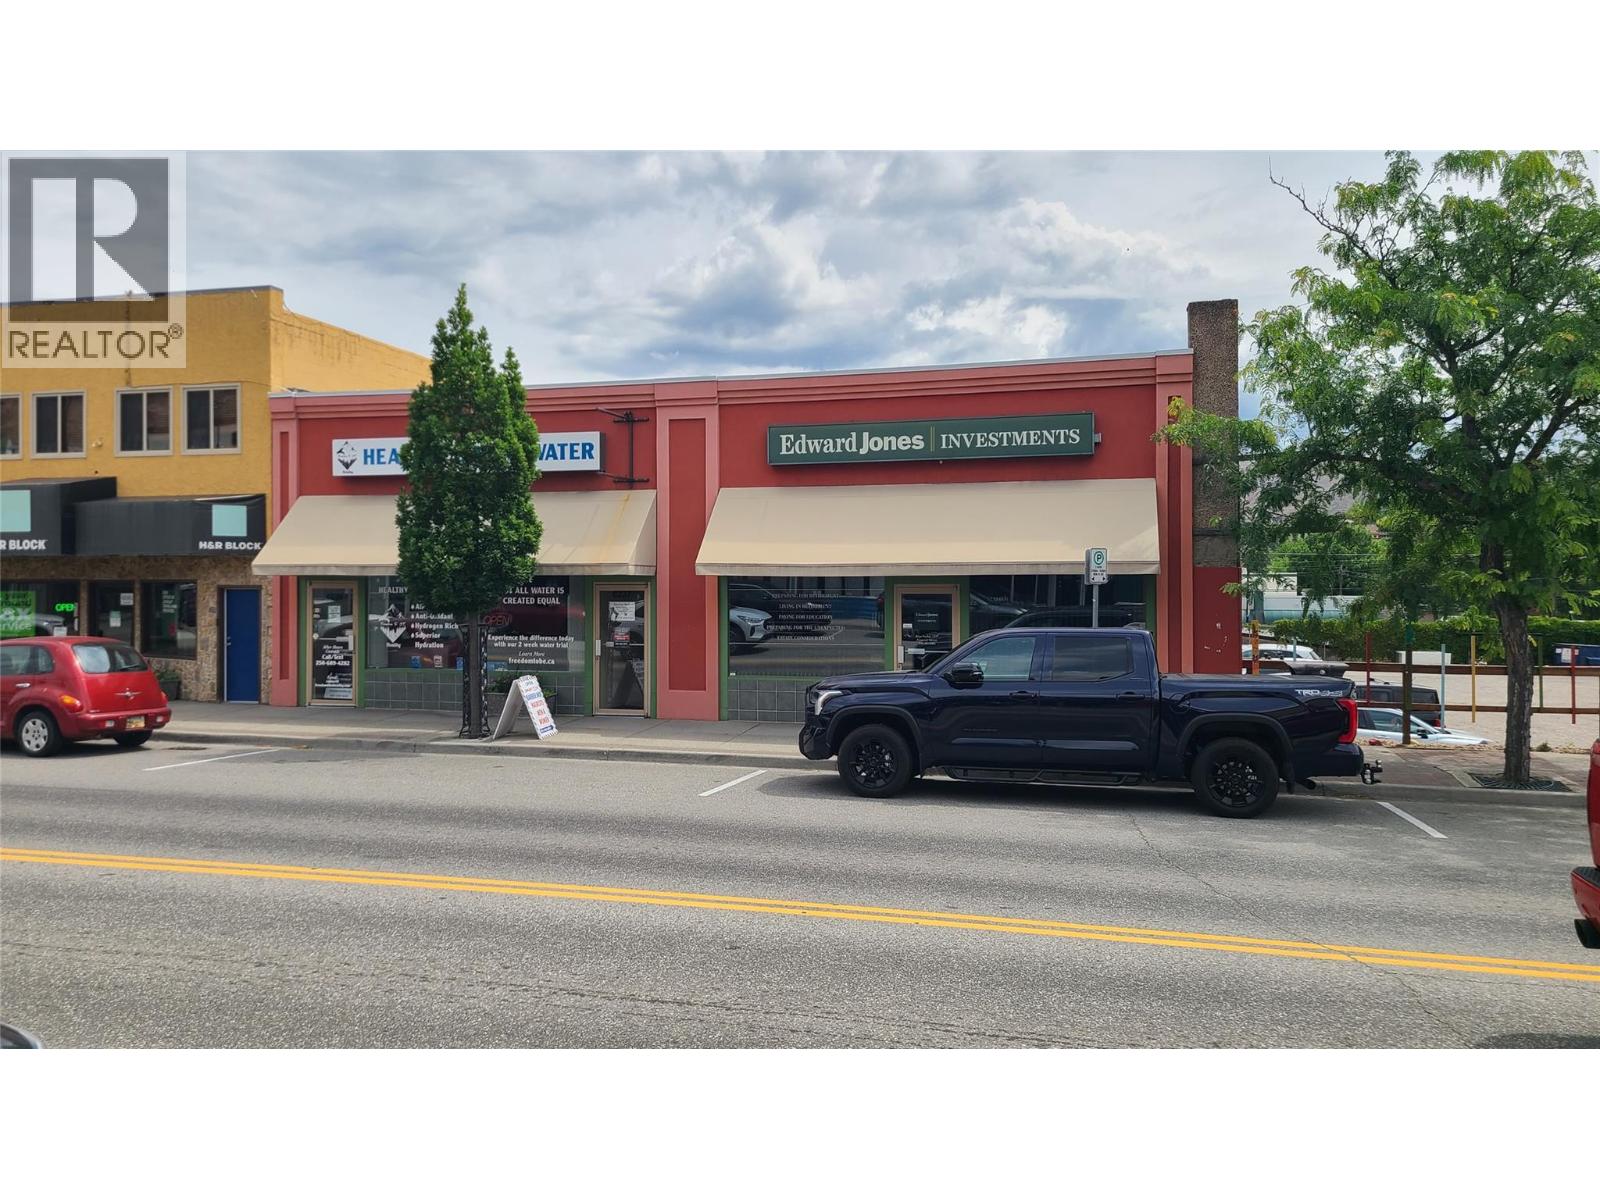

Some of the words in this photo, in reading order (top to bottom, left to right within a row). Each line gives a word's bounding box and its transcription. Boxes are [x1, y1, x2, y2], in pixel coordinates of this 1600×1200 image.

[779, 432, 858, 455] Edward
[859, 431, 925, 454] Jones
[940, 428, 1081, 450] INVESTMENTS
[363, 446, 401, 465] HEA
[8, 539, 47, 550] BLOCK
[199, 541, 223, 550] H&R
[225, 541, 262, 550] BLOCK
[378, 586, 408, 594] HEALTHY
[531, 586, 556, 594] WATER
[557, 586, 565, 594] IS
[503, 597, 535, 605] CREATED
[537, 597, 561, 605] EQUAL
